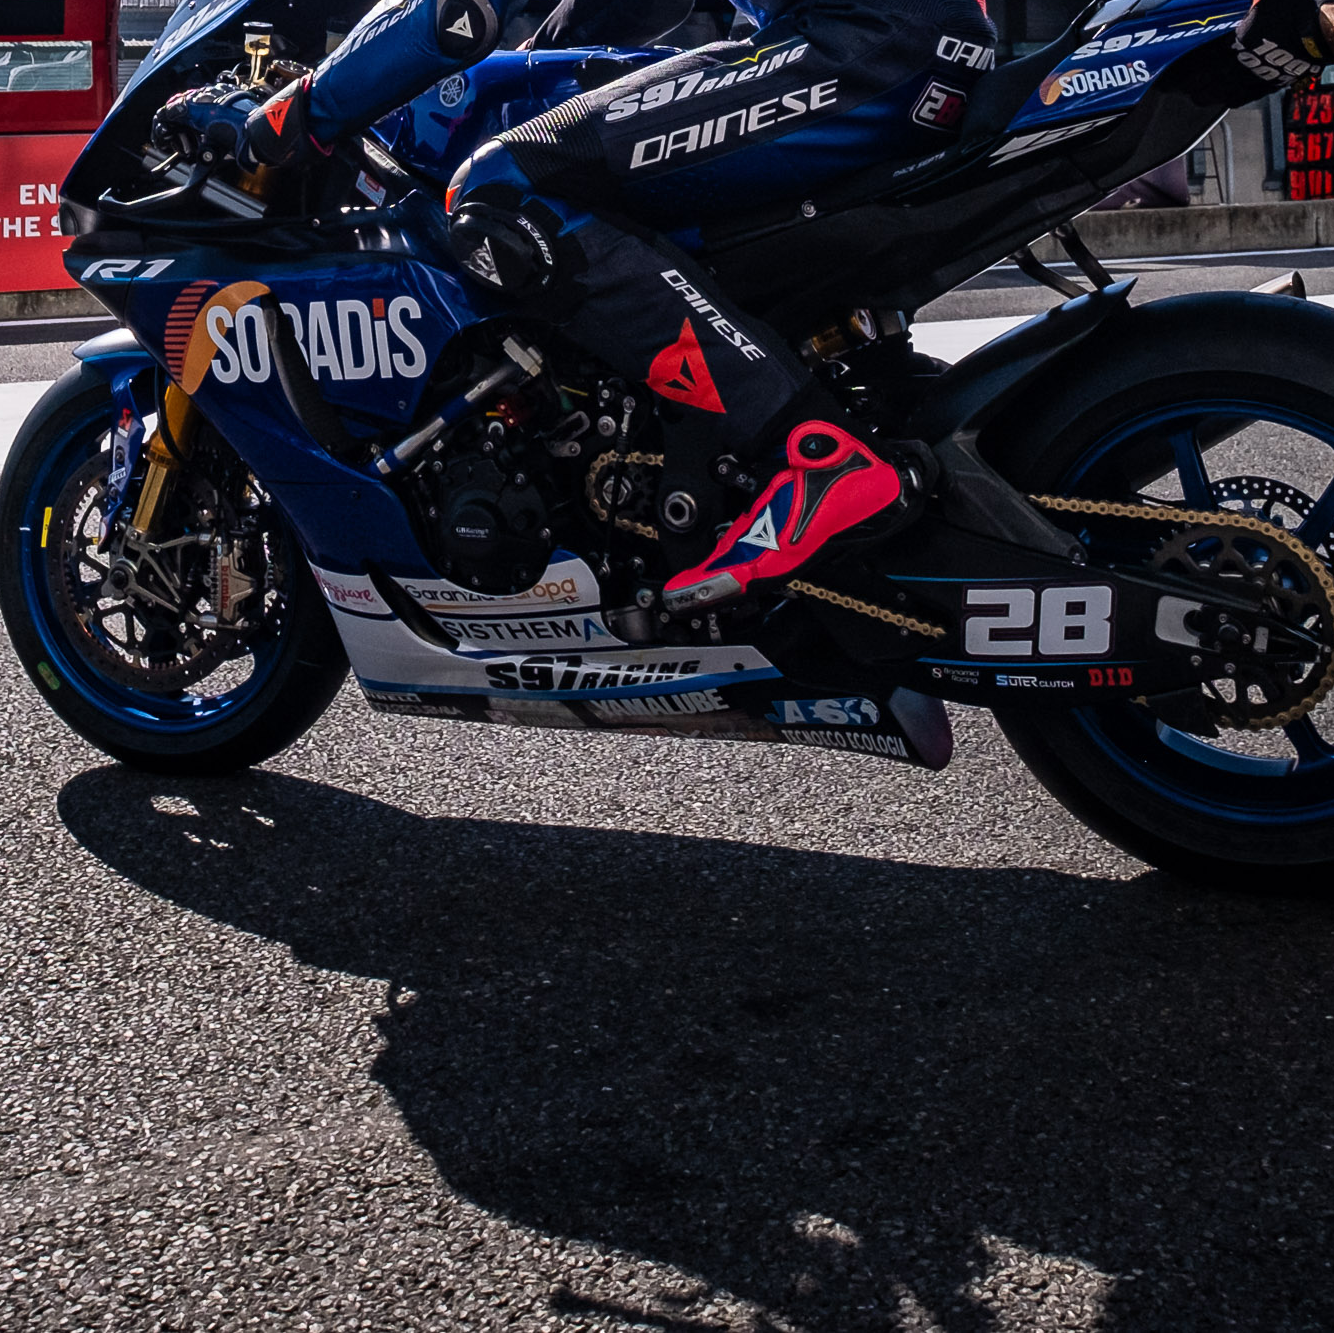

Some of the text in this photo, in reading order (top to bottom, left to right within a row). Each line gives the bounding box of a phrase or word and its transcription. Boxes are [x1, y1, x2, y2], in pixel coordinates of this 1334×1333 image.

[629, 78, 839, 170] DAINESE
[516, 217, 553, 266] DAINESE
[80, 258, 176, 282] R1
[660, 268, 767, 361] DAINESE
[964, 585, 1113, 656] 28
[588, 688, 731, 716] YAMALUBE
[782, 730, 909, 758] TECNOECO ECOLOGIA
